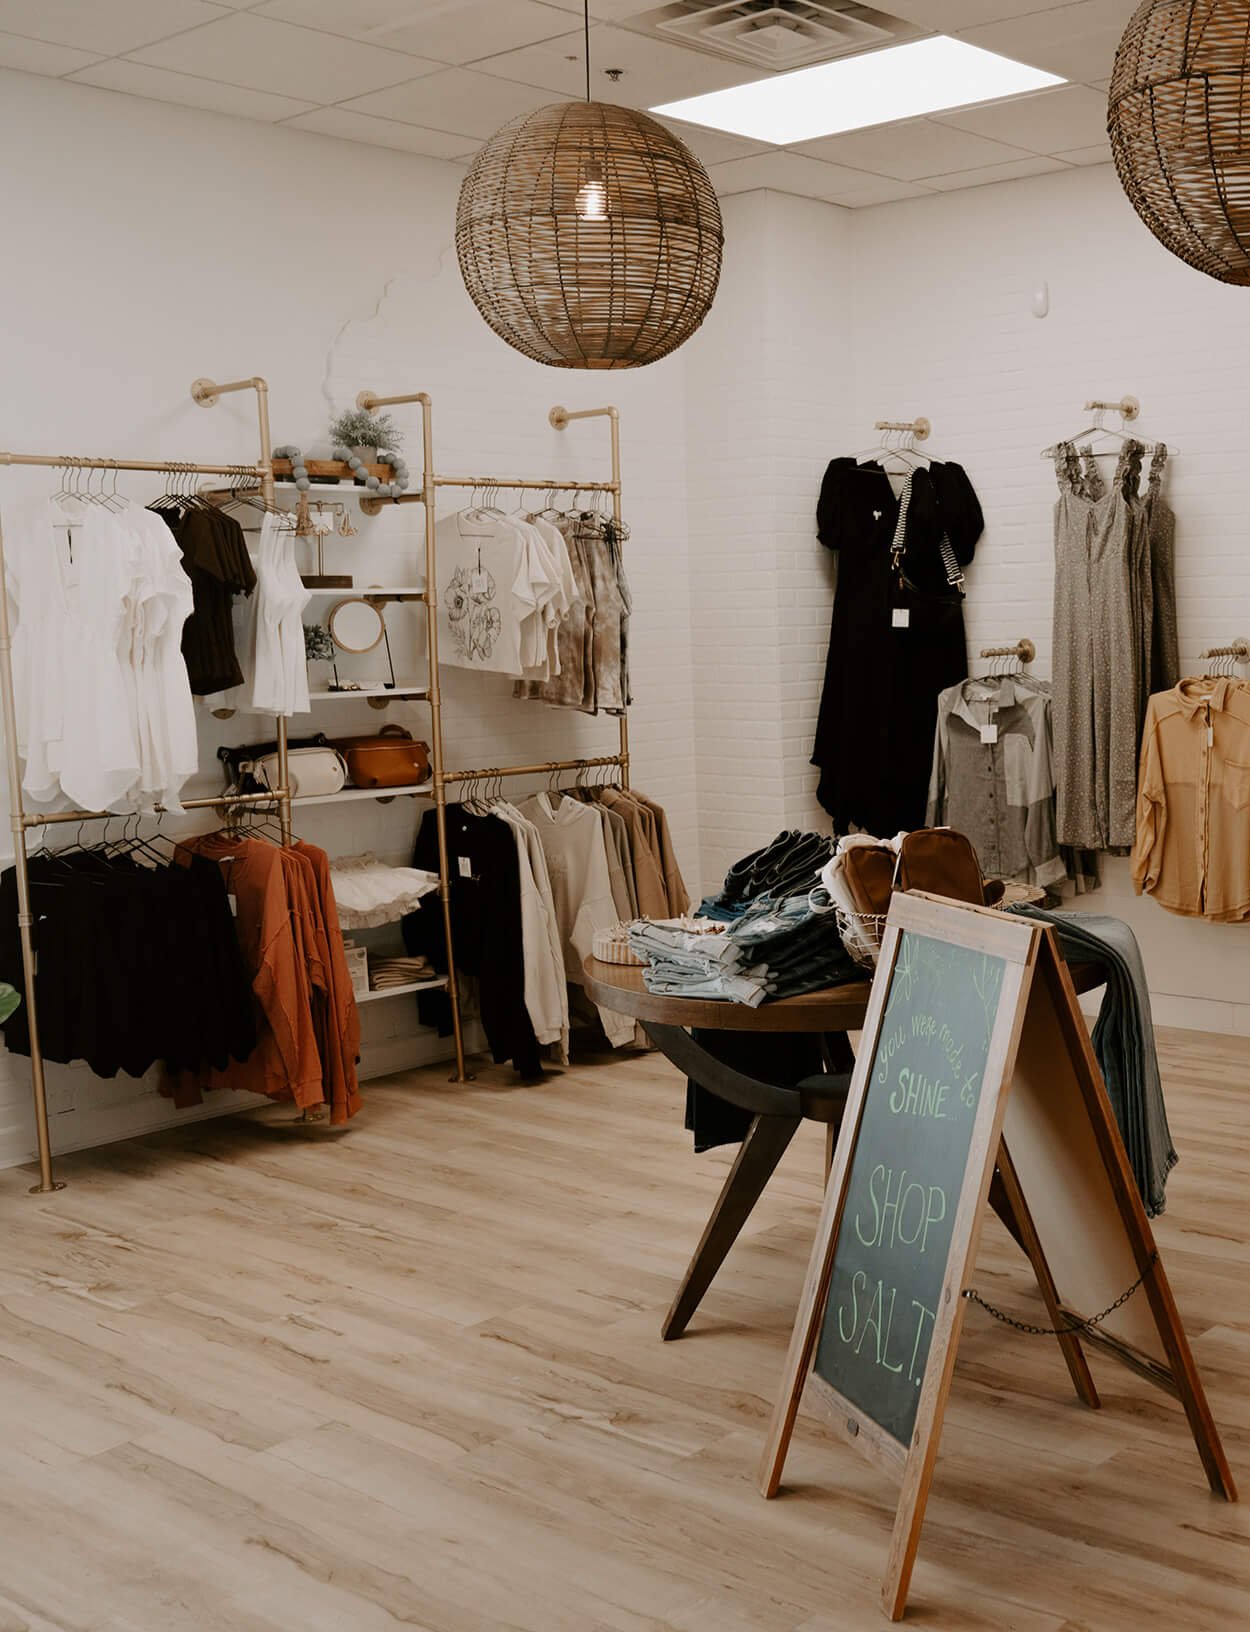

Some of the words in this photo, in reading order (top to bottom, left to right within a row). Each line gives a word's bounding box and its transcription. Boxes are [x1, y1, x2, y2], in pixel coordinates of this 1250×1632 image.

[879, 1025, 906, 1084] you
[939, 1022, 966, 1080] made
[960, 1071, 979, 1108] to
[855, 1164, 946, 1253] SHOP
